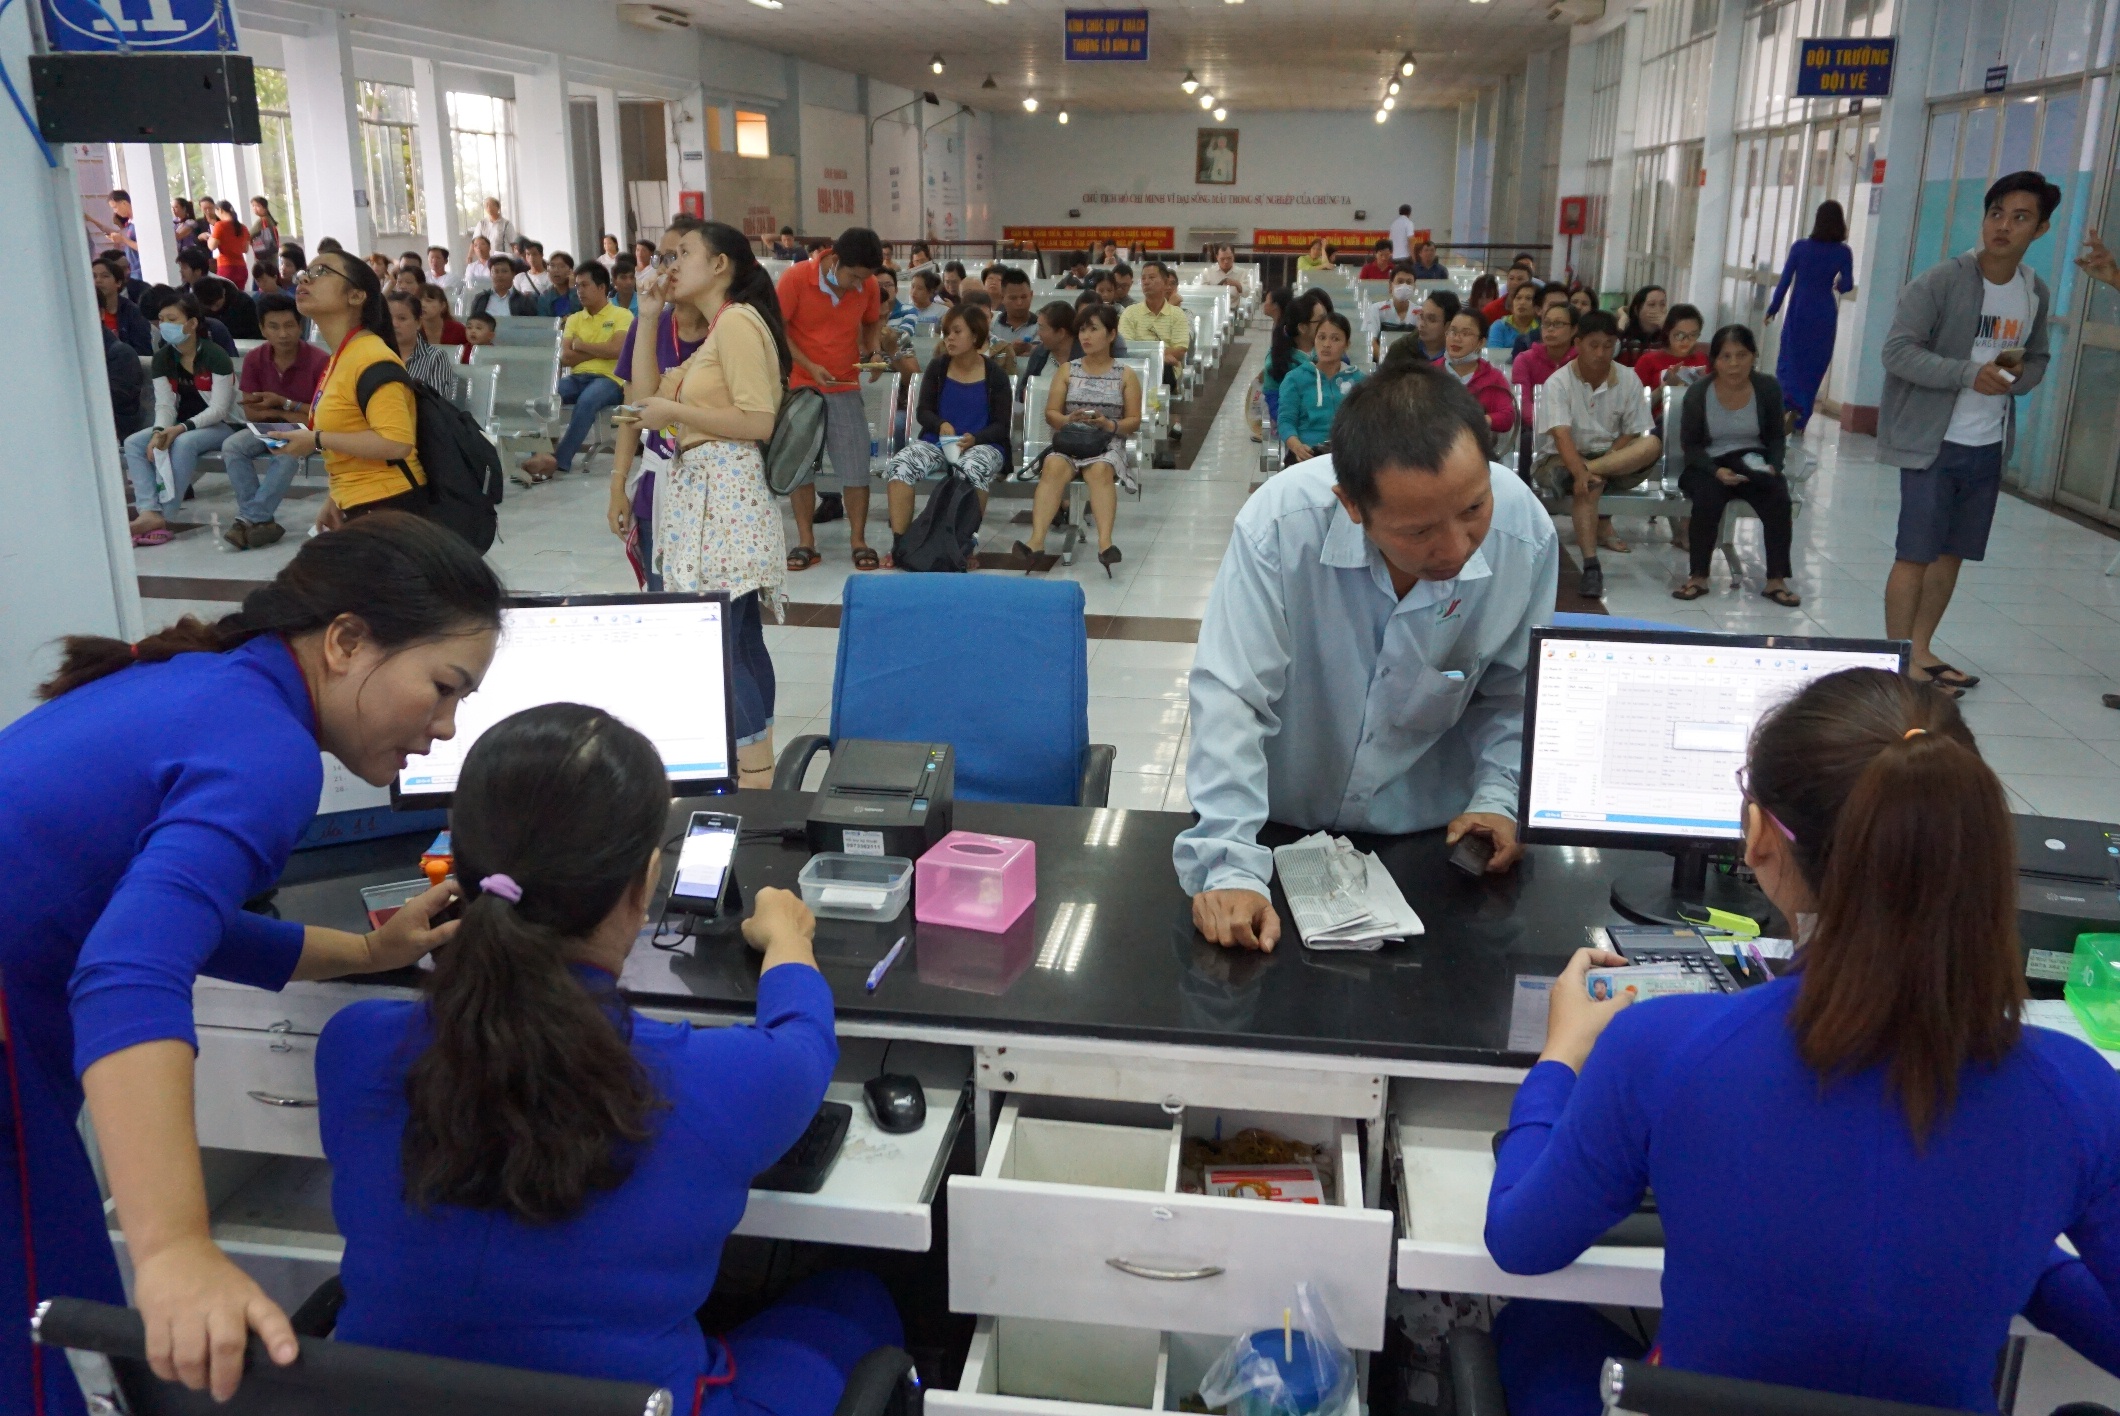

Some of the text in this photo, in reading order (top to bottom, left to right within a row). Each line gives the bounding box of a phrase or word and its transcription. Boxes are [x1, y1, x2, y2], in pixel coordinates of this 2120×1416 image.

[1820, 70, 1868, 92] ĐỘI VÉ
[1341, 195, 1352, 205] TA
